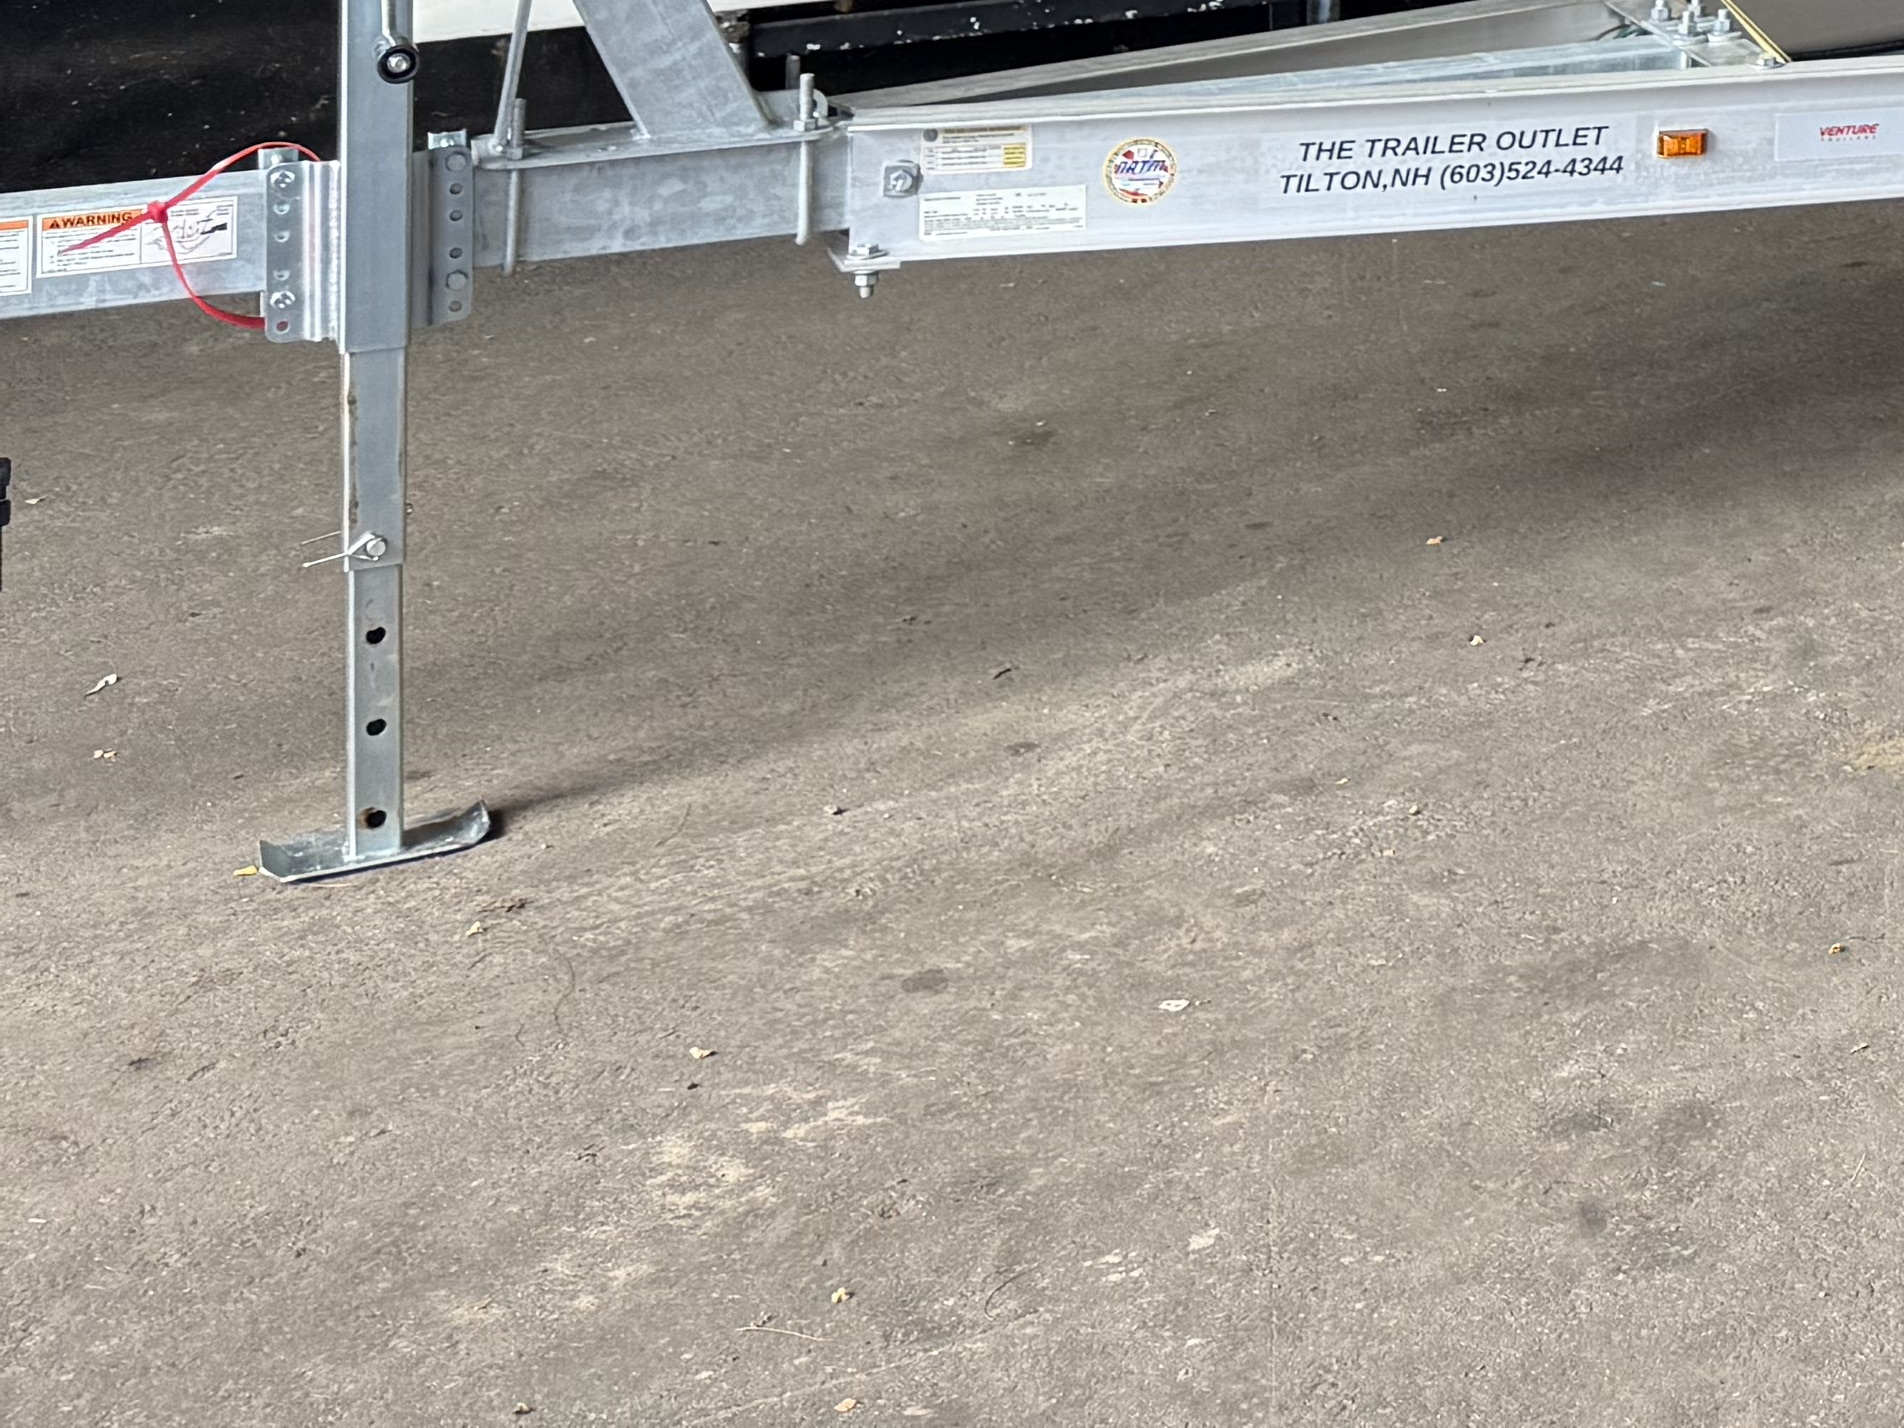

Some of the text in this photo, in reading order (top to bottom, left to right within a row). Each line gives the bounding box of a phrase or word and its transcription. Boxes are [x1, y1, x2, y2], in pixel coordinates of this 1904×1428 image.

[1820, 123, 1879, 136] VENTURE
[1299, 126, 1610, 162] THE TRAILER OUTLET
[1280, 155, 1624, 194] TILTON,NH (603)524-4344
[61, 211, 134, 228] WARNING
